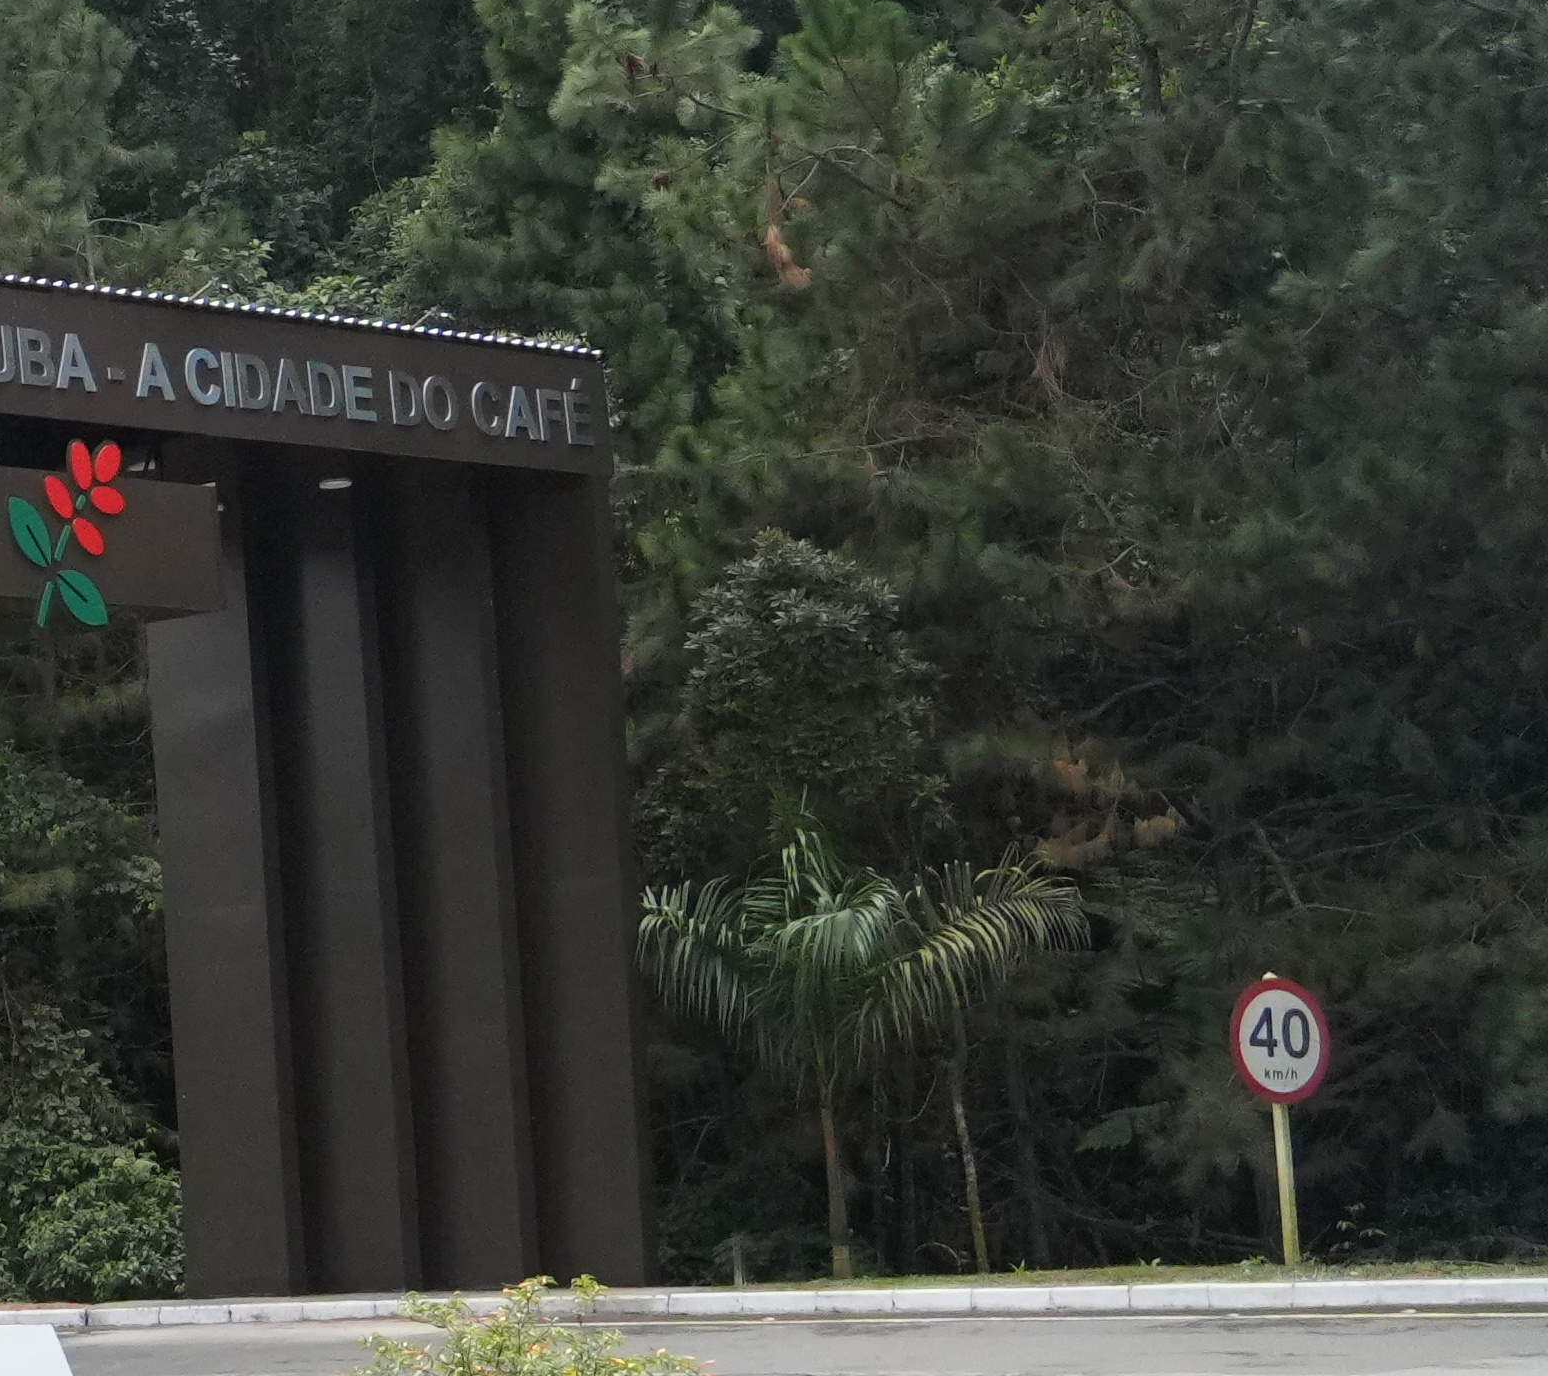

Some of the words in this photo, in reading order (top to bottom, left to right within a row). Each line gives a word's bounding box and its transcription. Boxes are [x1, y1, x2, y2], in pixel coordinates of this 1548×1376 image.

[137, 342, 177, 401] A
[185, 348, 379, 423] CIDADE
[388, 370, 455, 431] DO
[472, 378, 597, 446] CAFÉ
[1249, 1006, 1310, 1058] 40
[1264, 1067, 1298, 1080] km/h
